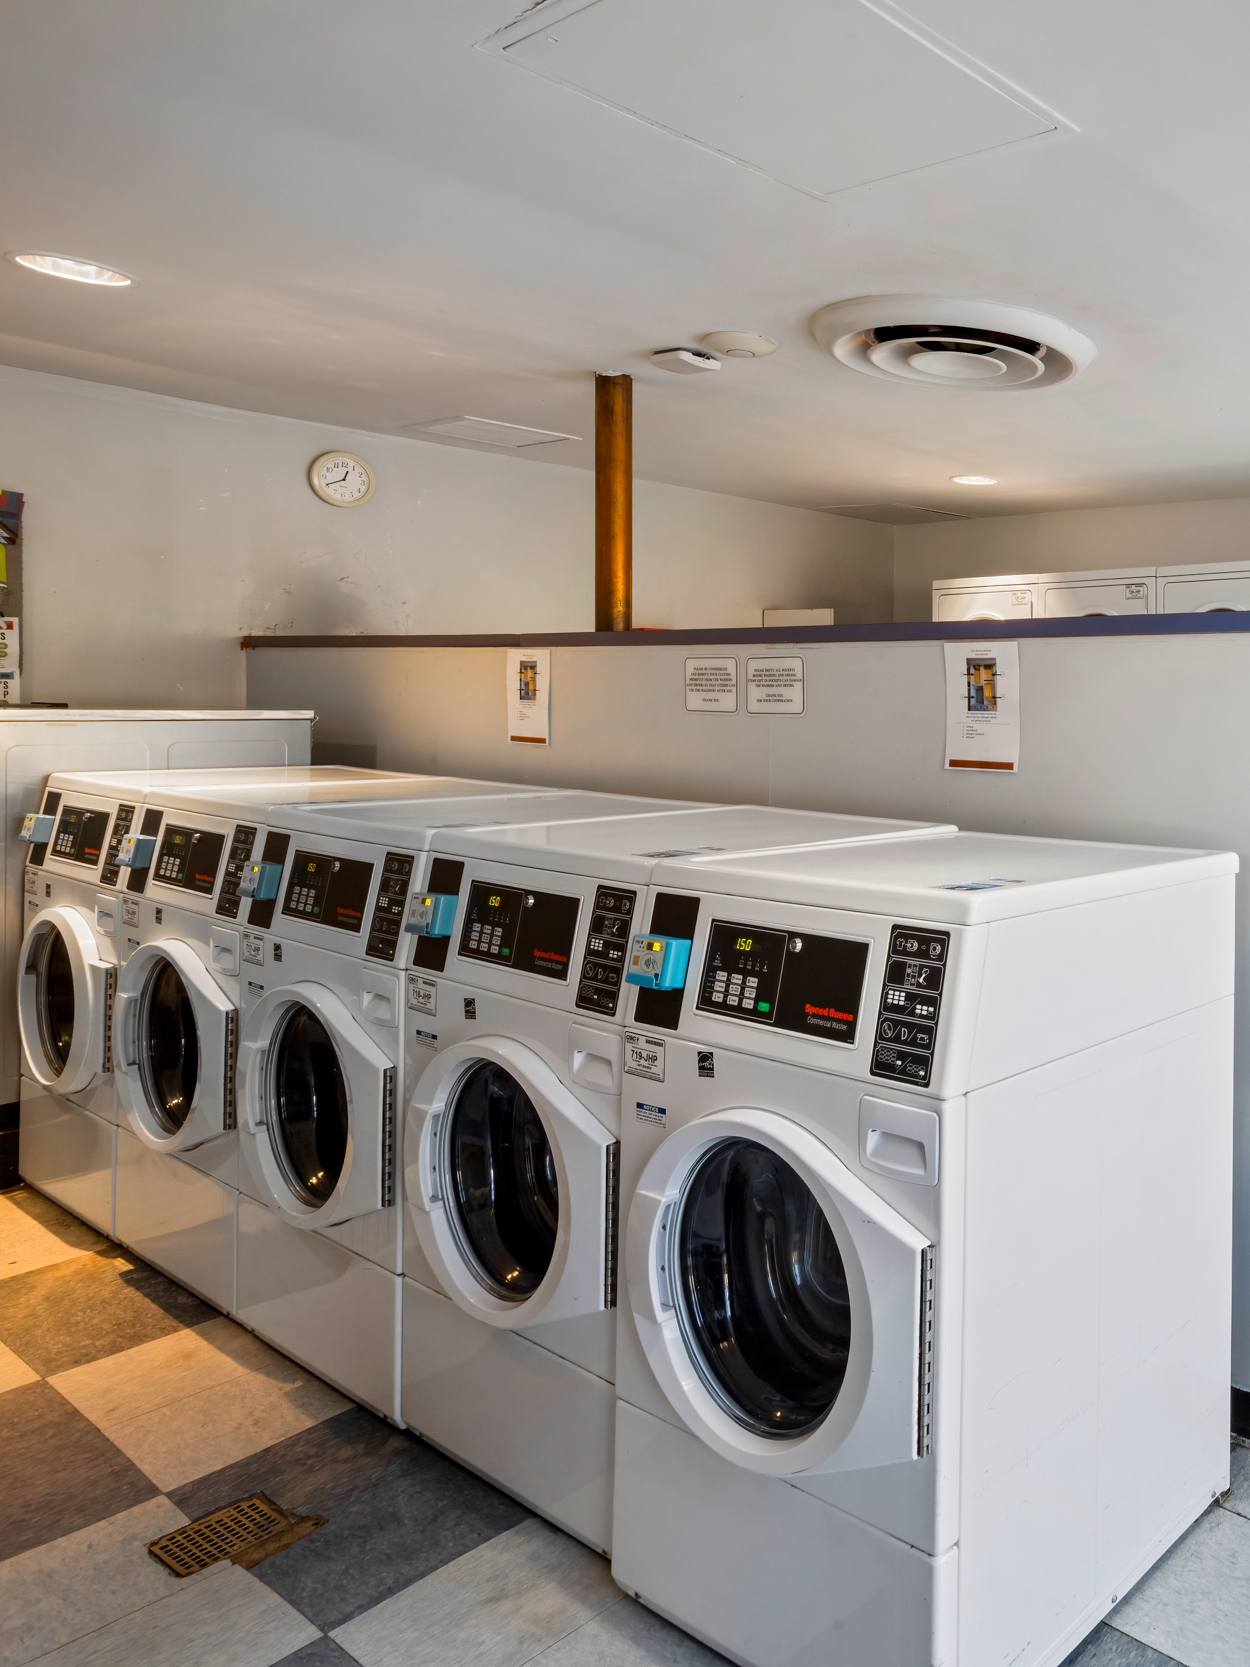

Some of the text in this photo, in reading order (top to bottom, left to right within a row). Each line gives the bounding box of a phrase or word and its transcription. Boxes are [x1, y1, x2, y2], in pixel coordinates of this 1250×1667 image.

[805, 1004, 853, 1021] Speed Queen
[807, 1016, 848, 1030] Commercial Washer
[631, 1050, 658, 1063] 719-JHP
